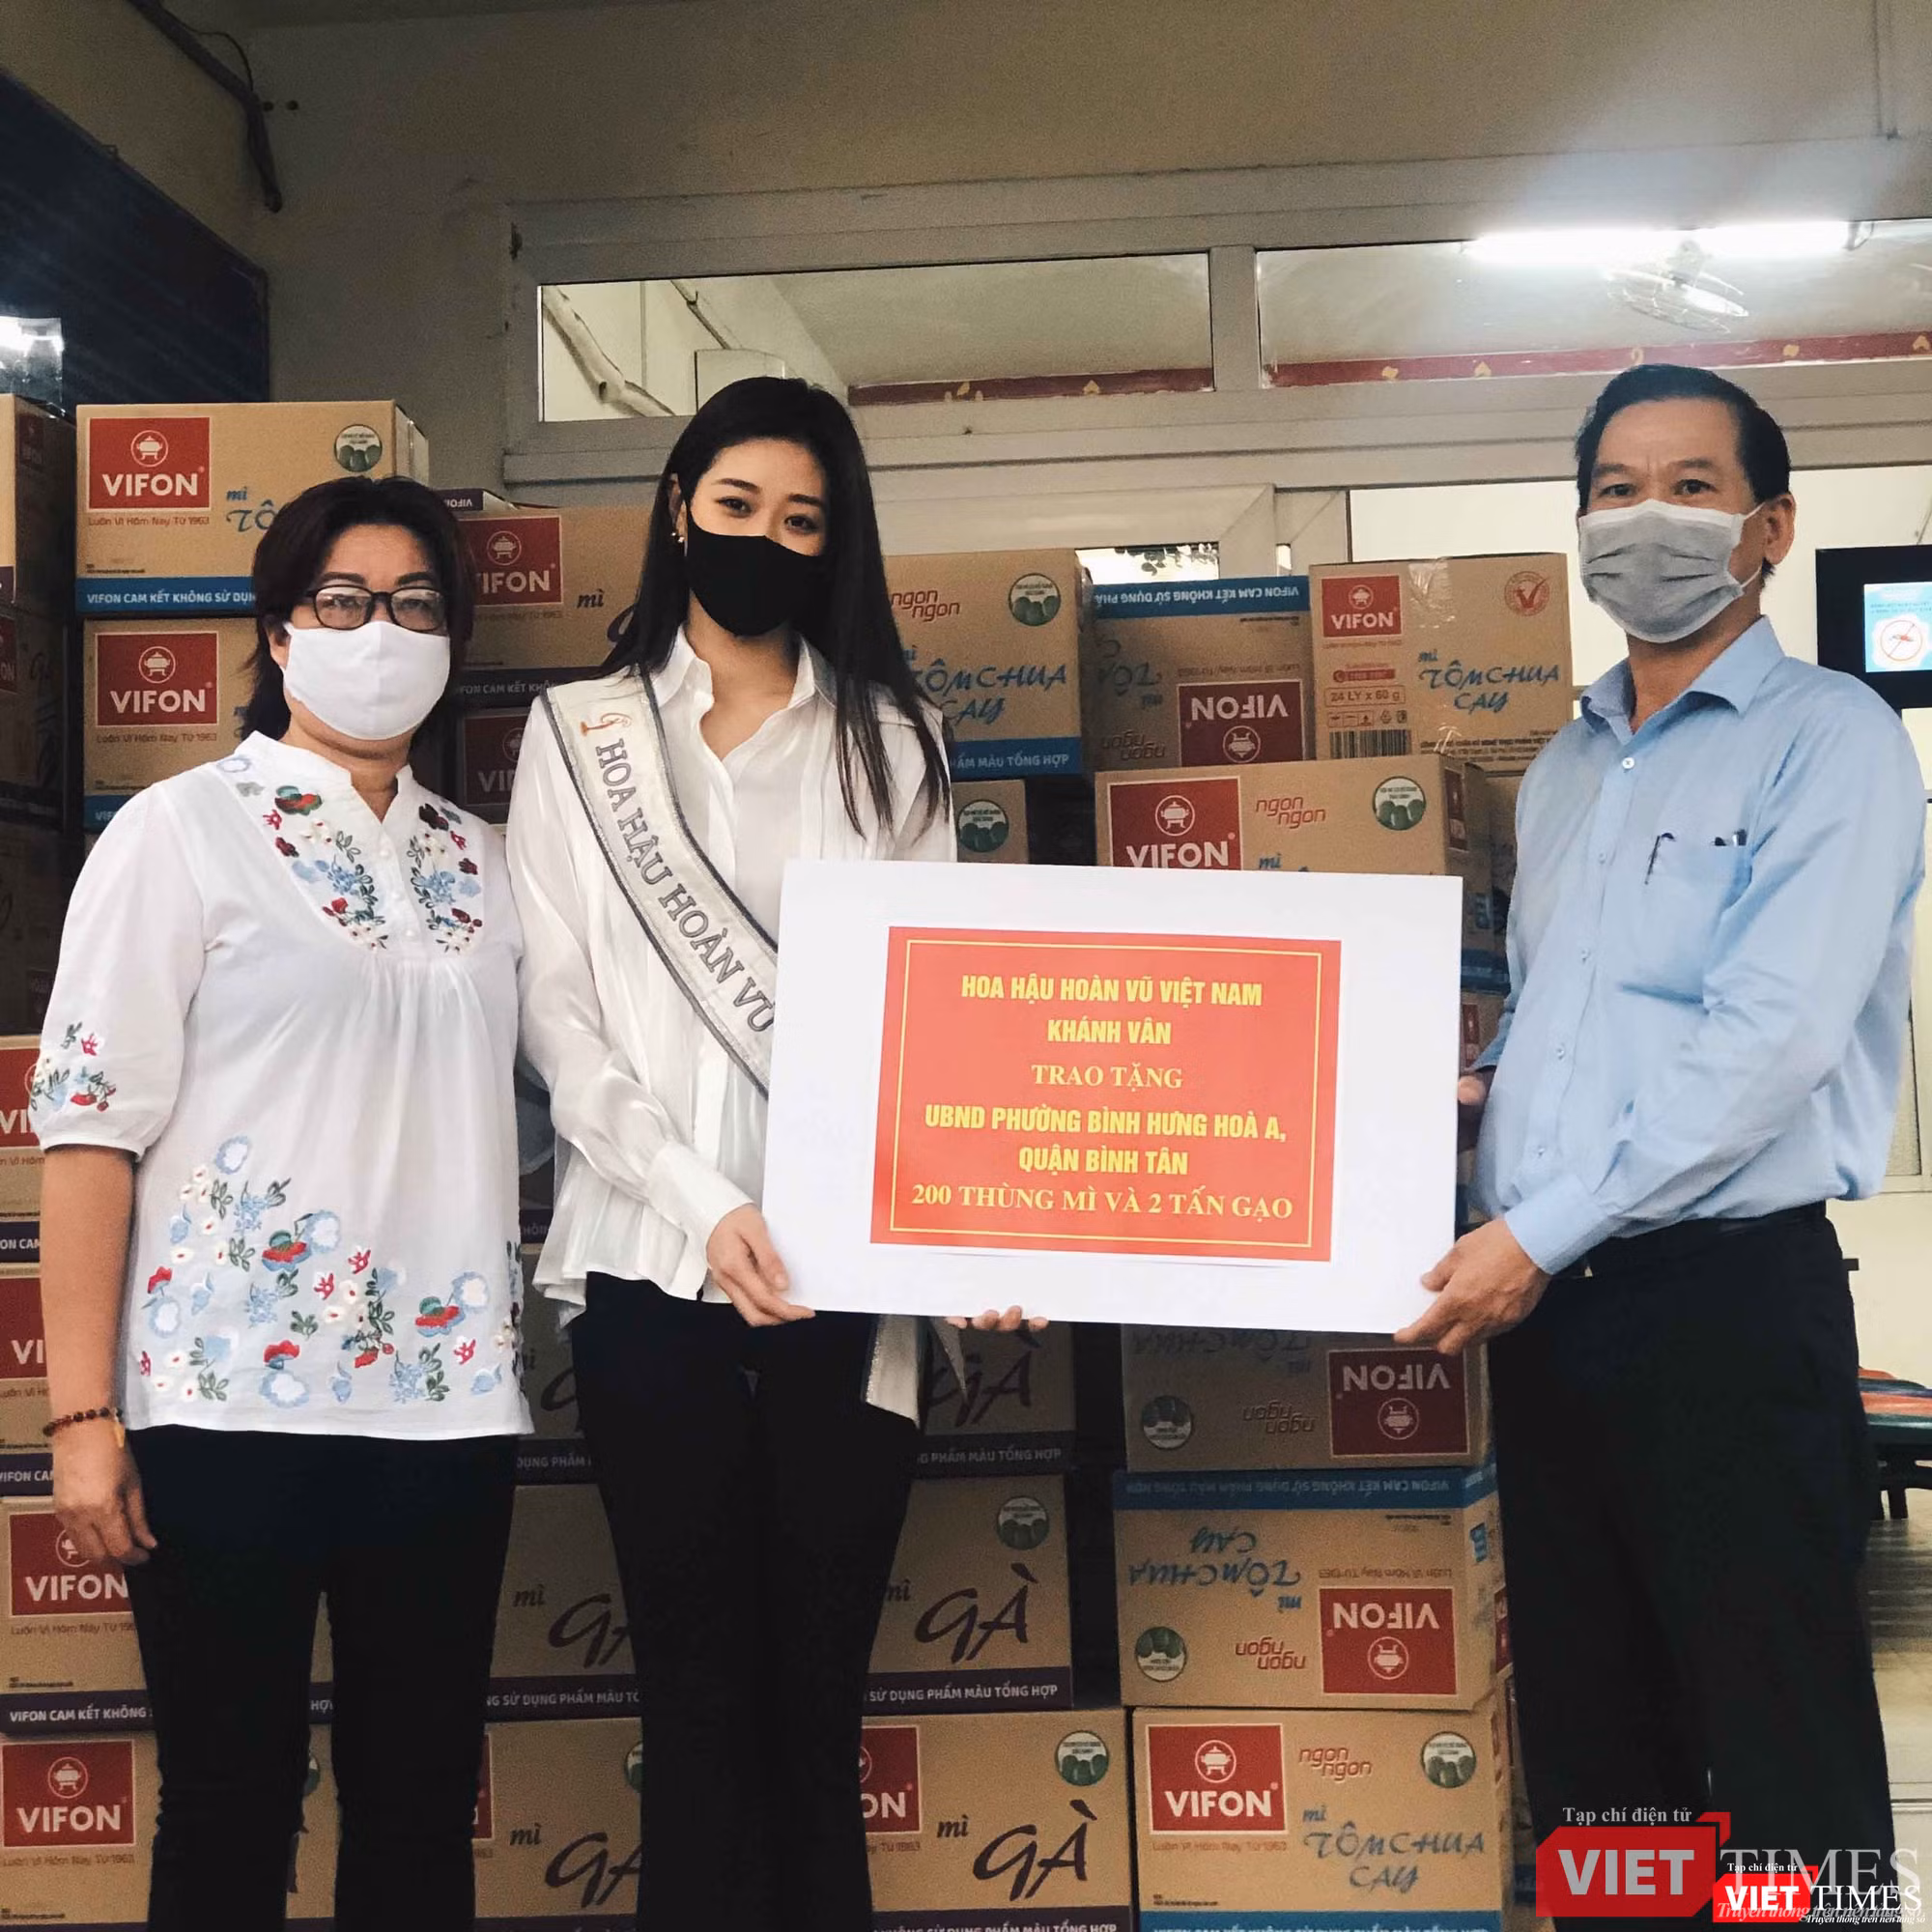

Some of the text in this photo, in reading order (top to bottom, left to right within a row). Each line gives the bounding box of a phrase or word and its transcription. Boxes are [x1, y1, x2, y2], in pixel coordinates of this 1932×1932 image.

[102, 473, 198, 497] VIFON
[226, 499, 278, 532] TÔ
[483, 570, 550, 594] IFON
[1238, 587, 1263, 598] CAM
[1264, 586, 1298, 598] VIFON
[87, 593, 121, 604] VIFON
[124, 592, 147, 604] CAM
[150, 588, 169, 603] KẾT
[173, 589, 212, 603] KHÔNG
[233, 593, 256, 607] DỤN
[577, 589, 605, 609] mì
[1174, 590, 1213, 604] KHÔNG
[911, 602, 959, 623] ngon
[1331, 611, 1394, 630] VIFON
[110, 689, 206, 713] VIFON
[1191, 695, 1289, 721] VIFON
[1453, 691, 1509, 714] CAY
[1256, 795, 1304, 816] ngon
[1278, 809, 1326, 829] ngon
[596, 738, 637, 812] HOA
[617, 808, 673, 886] HẬU
[658, 882, 745, 984] HOÀN
[1126, 840, 1229, 868] VIFON
[961, 973, 1263, 1009] HOA HẬU HOÀN VŨ VIỆT NAM
[1047, 1015, 1172, 1045] KHÁNH VÂN
[1031, 1062, 1183, 1093] TRAO TẶNG
[925, 1103, 1287, 1143] UBND PHƯỜNG BÌNH HƯNG HOÀ A,
[1019, 1144, 1188, 1176] QUẬN BÌNH TÂN
[912, 1179, 1293, 1224] 200 THÙNG MÌ VÀ 2 TẤN GẠO
[1343, 1362, 1450, 1392] VIFON
[25, 1573, 128, 1602] VIFON
[512, 1583, 547, 1608] mì
[1333, 1602, 1439, 1629] VIFON
[1236, 1636, 1284, 1656] ngon
[1258, 1651, 1306, 1670] ngon
[964, 1684, 991, 1699] MÀU
[995, 1680, 1029, 1697] TỔNG
[1032, 1684, 1058, 1698] HỢP
[10, 1703, 147, 1722] VIFON CAM KẾT KHÔNG
[1298, 1745, 1349, 1768] ngon
[1321, 1760, 1372, 1782] ngon
[1165, 1789, 1271, 1817] VIFON
[16, 1804, 121, 1833] VIFON
[937, 1814, 969, 1838] mì
[509, 1822, 543, 1846] mì
[1349, 1864, 1418, 1893] CAY
